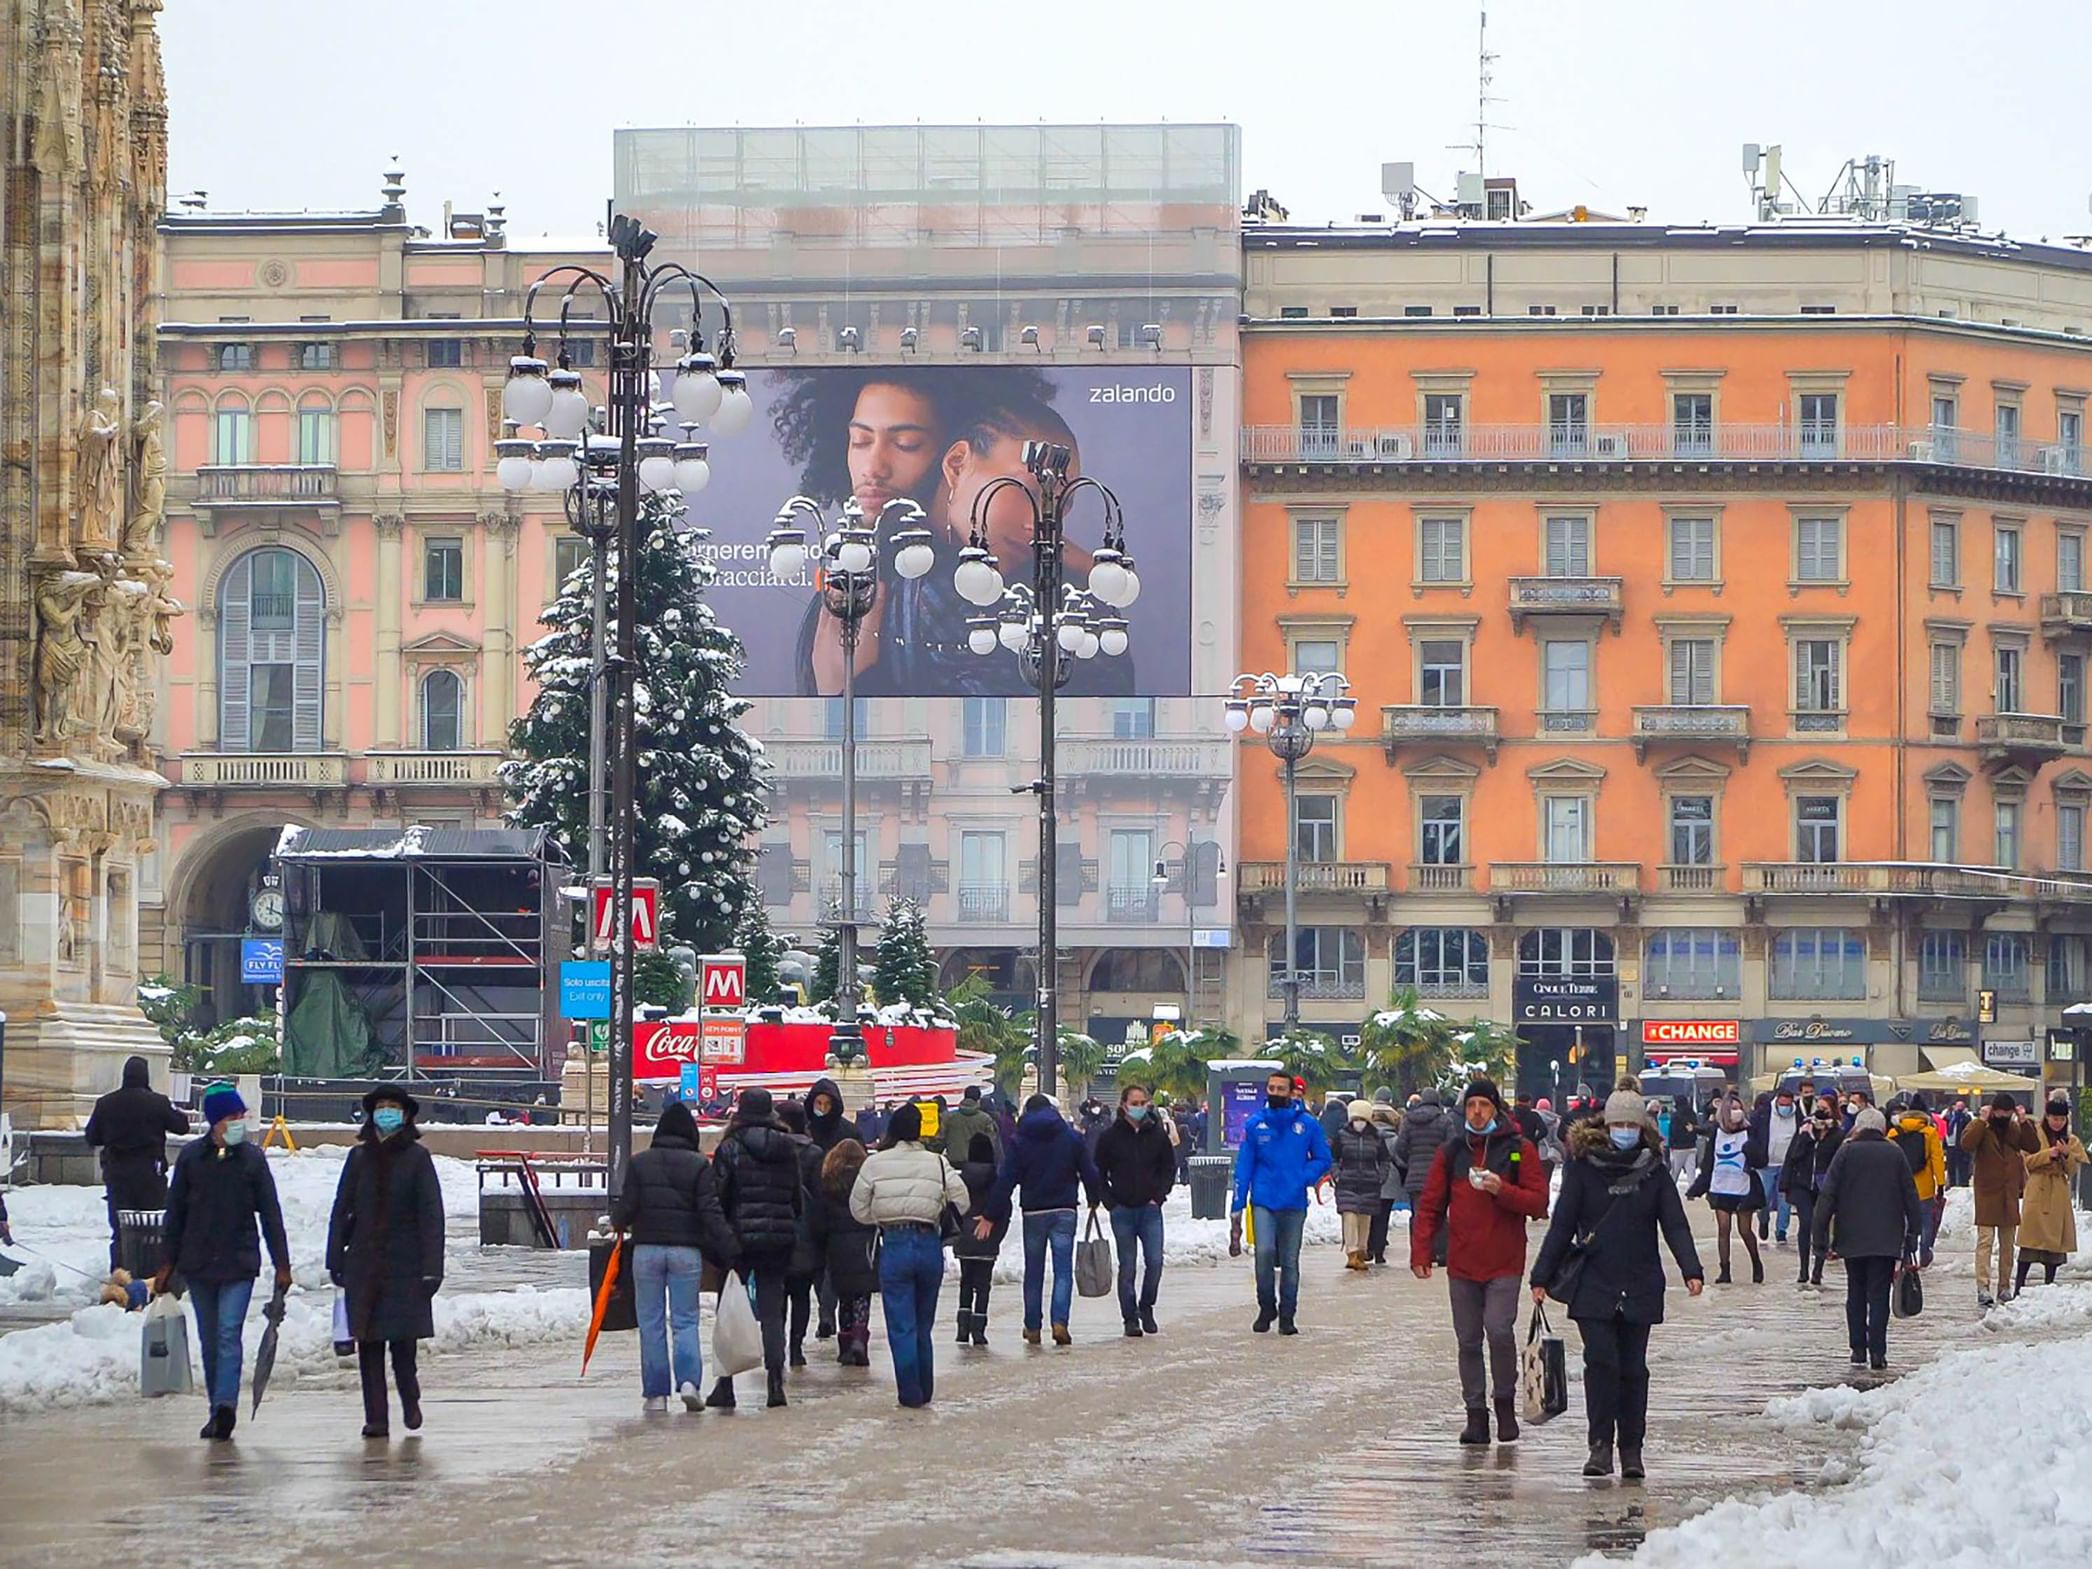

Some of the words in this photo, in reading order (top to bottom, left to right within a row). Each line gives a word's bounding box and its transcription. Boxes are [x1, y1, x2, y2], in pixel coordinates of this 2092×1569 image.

[1089, 383, 1175, 403] zalando
[248, 961, 267, 970] FLY
[564, 977, 584, 987] Solo
[706, 970, 741, 997] M
[569, 991, 586, 1002] Exit
[587, 991, 606, 1004] only
[1525, 1005, 1606, 1017] CALORI
[1658, 1025, 1735, 1039] CHANGE
[1774, 1022, 1804, 1039] Bar
[1804, 1023, 1852, 1039] Duomo
[646, 1026, 698, 1061] Coca
[1988, 1043, 2020, 1059] change
